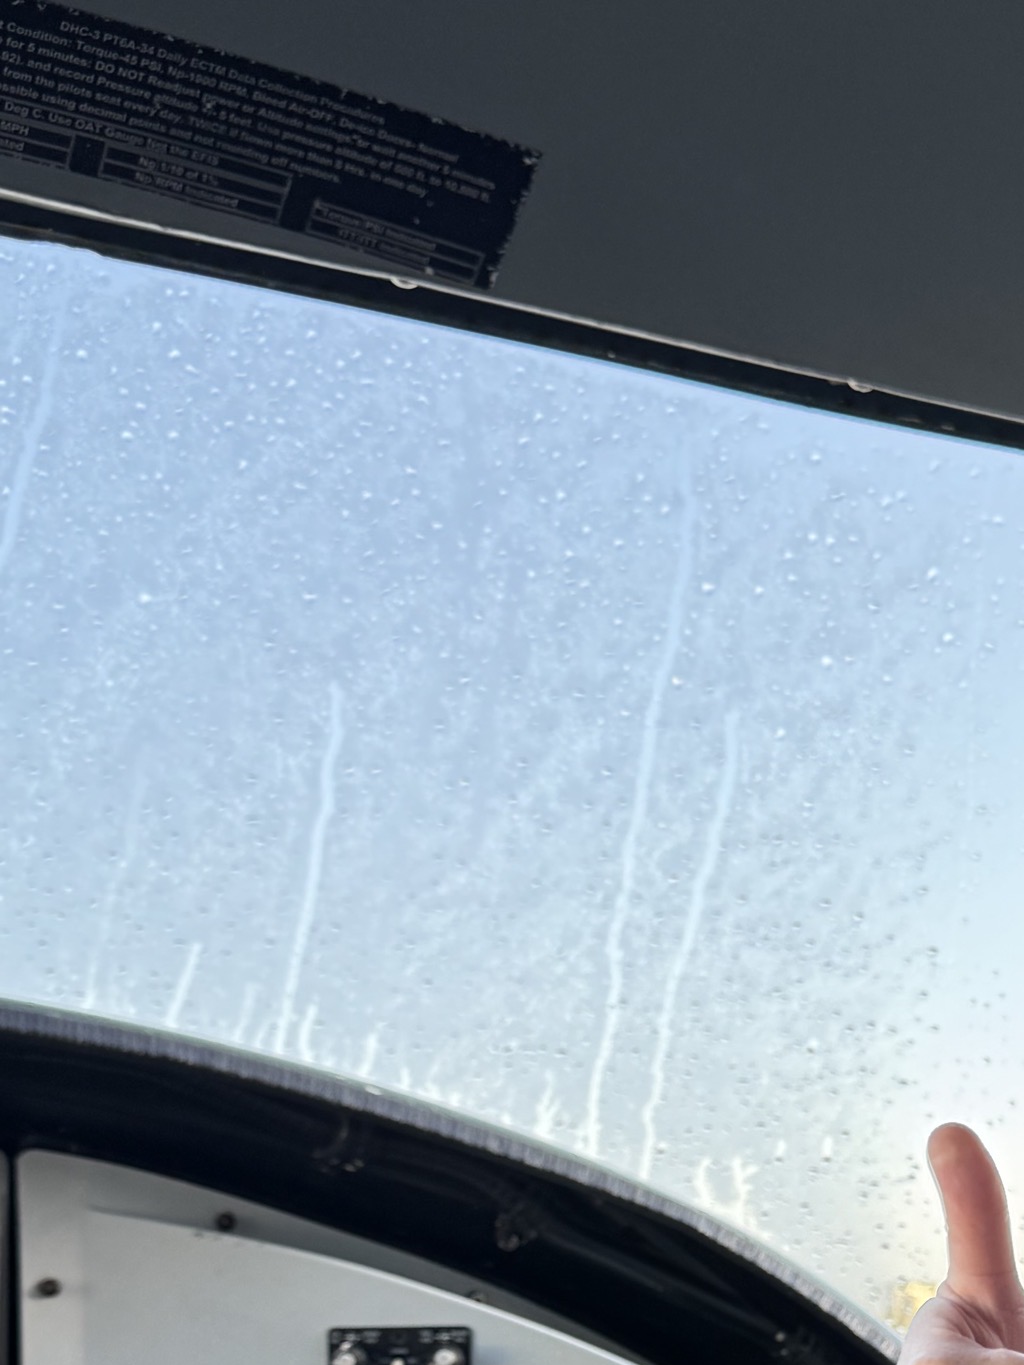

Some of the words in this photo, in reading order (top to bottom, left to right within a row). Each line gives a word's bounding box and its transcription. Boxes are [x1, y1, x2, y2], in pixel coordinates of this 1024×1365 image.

[5, 36, 25, 50] for
[37, 44, 92, 68] minutes:
[94, 60, 115, 74] DO
[116, 66, 144, 82] NOT
[146, 74, 200, 100] Readjust
[201, 92, 239, 112] power
[256, 106, 304, 129] Altitude
[6, 21, 73, 48] Condition:
[74, 40, 138, 68] Torque-45
[251, 90, 287, 109] Bleed
[59, 20, 100, 40] DHC-3
[102, 32, 154, 56] PT6A-34
[155, 48, 188, 67] Daily
[189, 57, 226, 76] ECTM
[227, 68, 257, 85] Data
[257, 77, 318, 104] Collection
[319, 96, 385, 126] Procedures
[0, 80, 39, 99] ssible
[40, 91, 77, 112] using
[78, 101, 126, 123] decimal
[128, 115, 167, 136] points
[168, 126, 193, 141] and
[193, 133, 215, 147] not
[214, 139, 269, 165] rounding
[270, 155, 288, 168] off
[2, 65, 33, 82] from
[34, 74, 56, 89] the
[56, 80, 93, 101] pilots
[93, 91, 122, 107] seat
[121, 100, 157, 118] every
[188, 116, 228, 135] TWICE
[229, 127, 238, 138] if
[273, 143, 305, 159] more
[306, 150, 333, 167] than
[369, 170, 382, 182] in
[382, 176, 405, 190] one
[2, 100, 30, 117] Deg
[47, 111, 73, 126] Use
[74, 118, 103, 134] OAT
[103, 126, 144, 147] Gauge
[169, 143, 189, 157] the
[26, 57, 51, 72] and
[52, 64, 94, 84] record
[95, 75, 152, 100] Pressure
[153, 92, 199, 113] altitude
[256, 121, 280, 137] Use
[280, 131, 333, 155] pressure
[334, 145, 378, 167] altitude
[378, 158, 393, 171] of
[154, 176, 183, 192] RPM
[183, 184, 238, 208] Indicated
